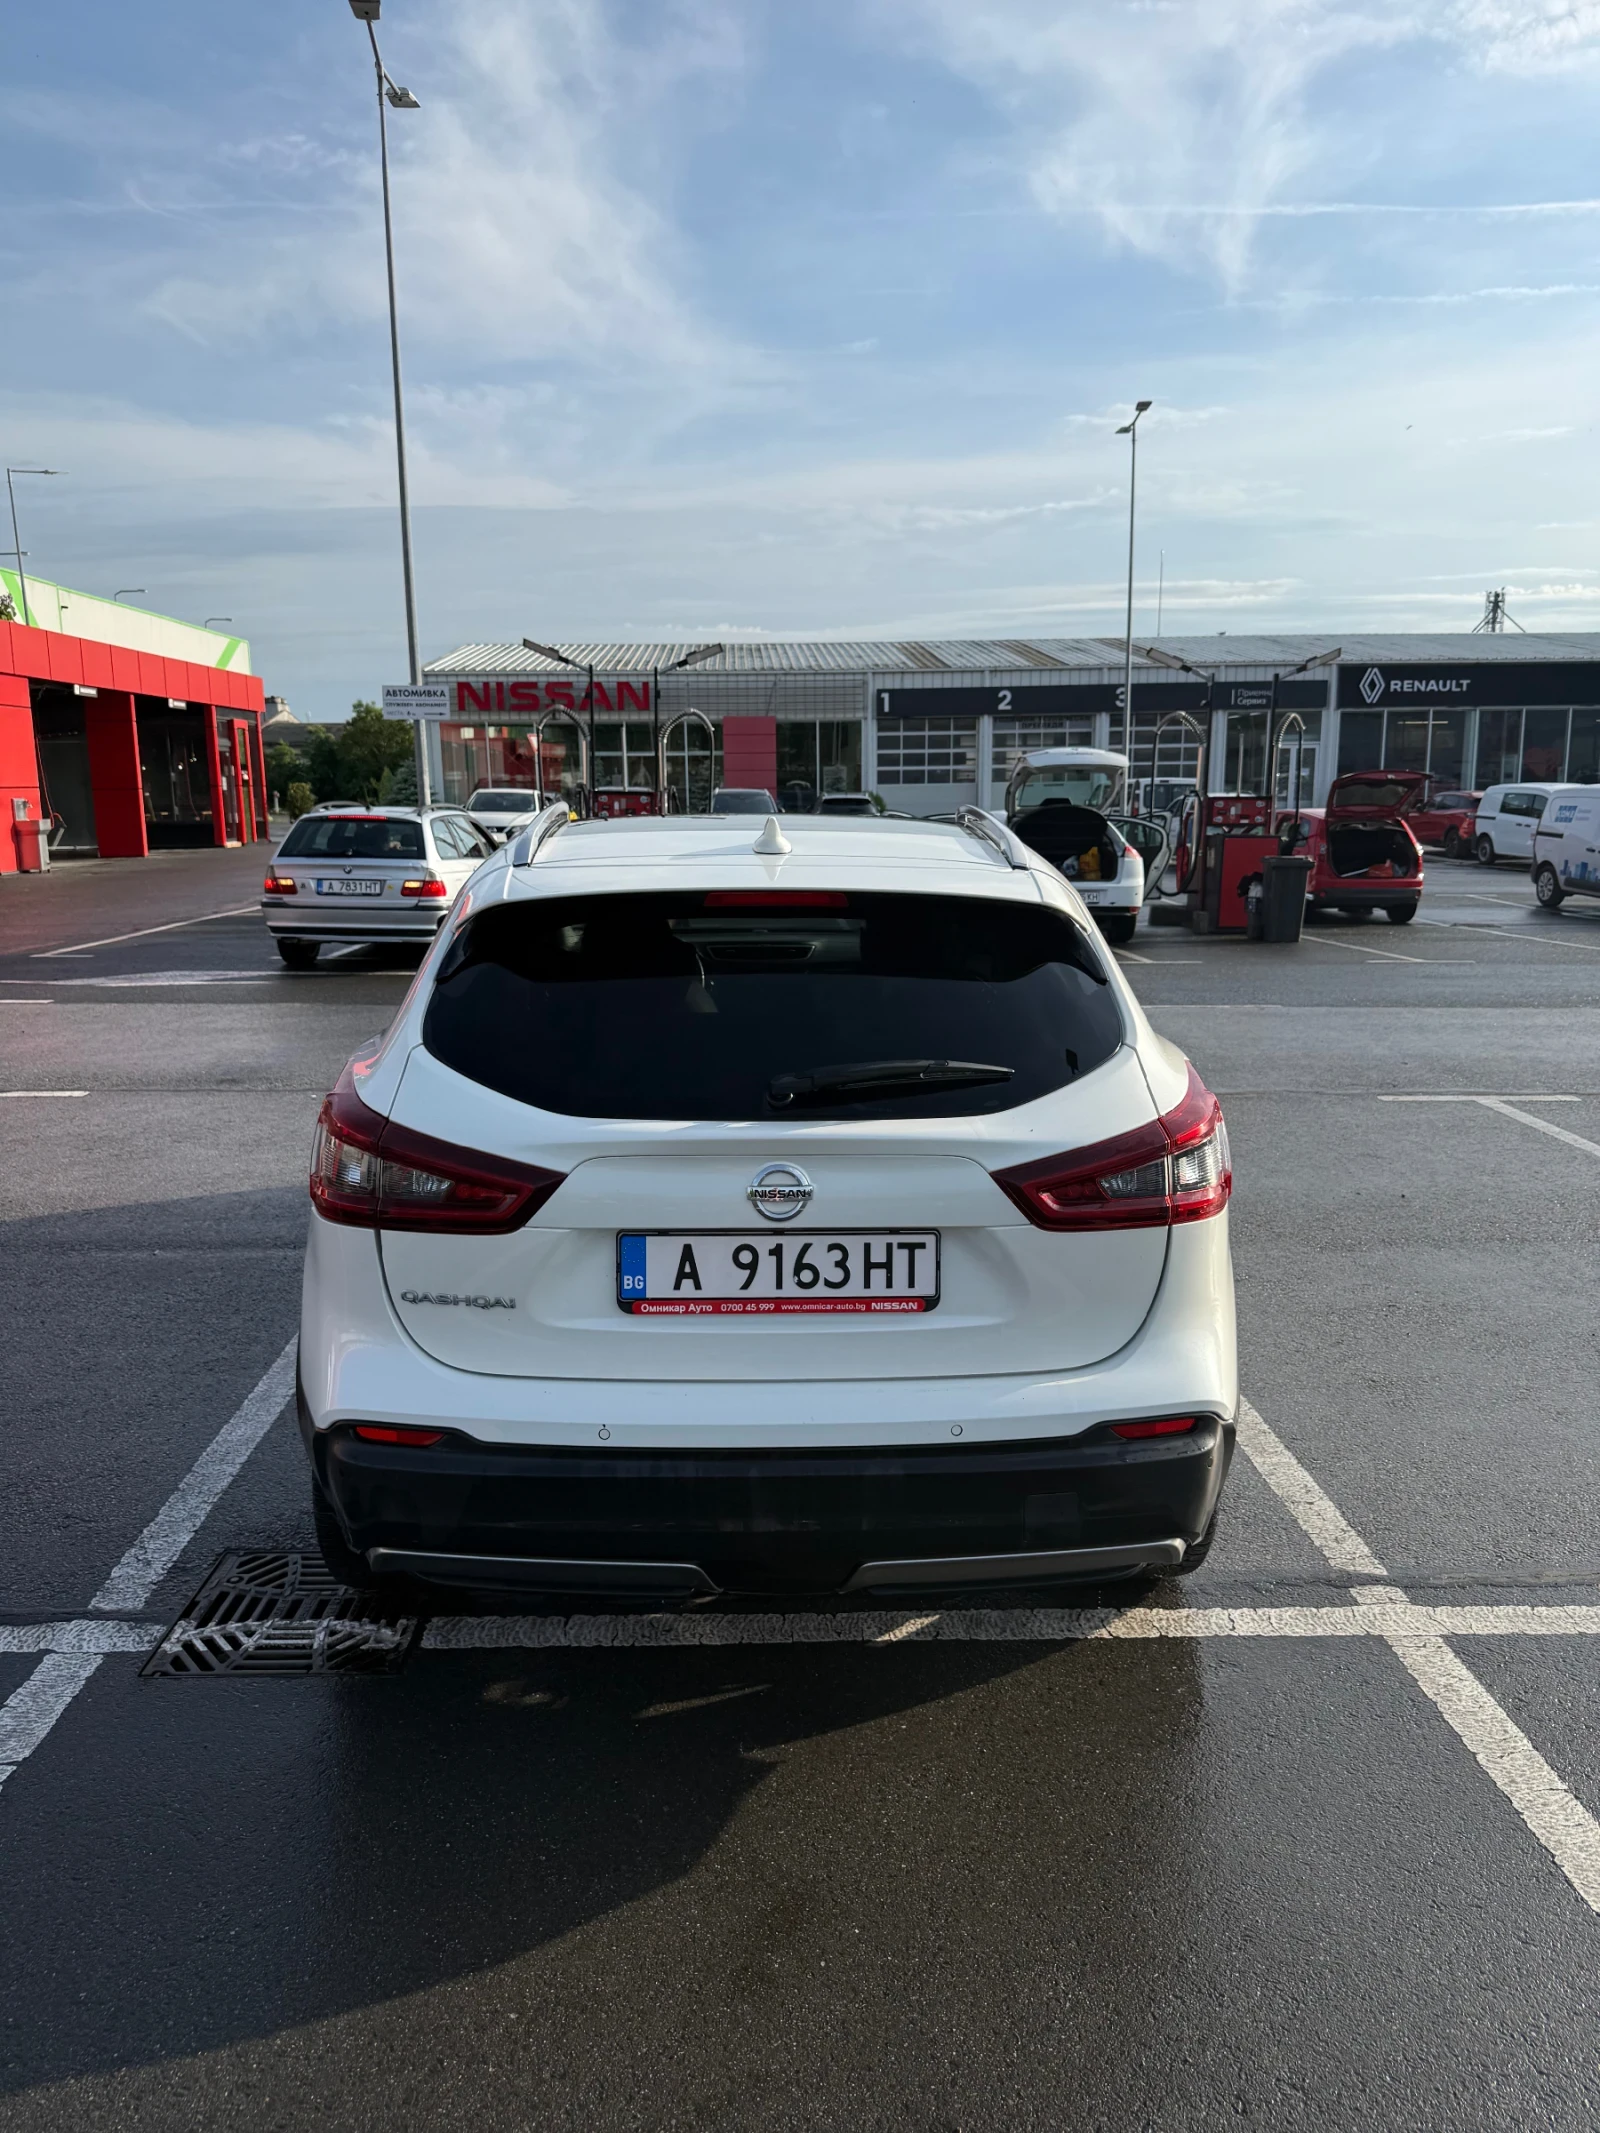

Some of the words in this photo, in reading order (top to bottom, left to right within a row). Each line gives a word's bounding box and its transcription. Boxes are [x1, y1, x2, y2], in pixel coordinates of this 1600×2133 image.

[1389, 679, 1471, 692] RENAULT
[385, 689, 446, 698] АВТОМИВКА
[456, 681, 650, 711] NISSAN
[997, 690, 1012, 711] 2
[1115, 687, 1126, 707] 3
[880, 692, 890, 713] 1
[1237, 697, 1266, 706] Сервиз
[328, 881, 334, 892] A
[754, 1189, 806, 1199] NISSAN
[673, 1243, 702, 1291] A
[623, 1275, 644, 1290] BG
[400, 1289, 517, 1310] QASHQAI
[641, 1303, 686, 1313] Омникар
[688, 1303, 713, 1312] Ауто
[721, 1303, 743, 1312] 0700
[745, 1303, 757, 1311] 45
[759, 1303, 775, 1311] 999
[781, 1302, 866, 1311] www.omnicar-auto.bg
[871, 1302, 918, 1310] NISSAN
